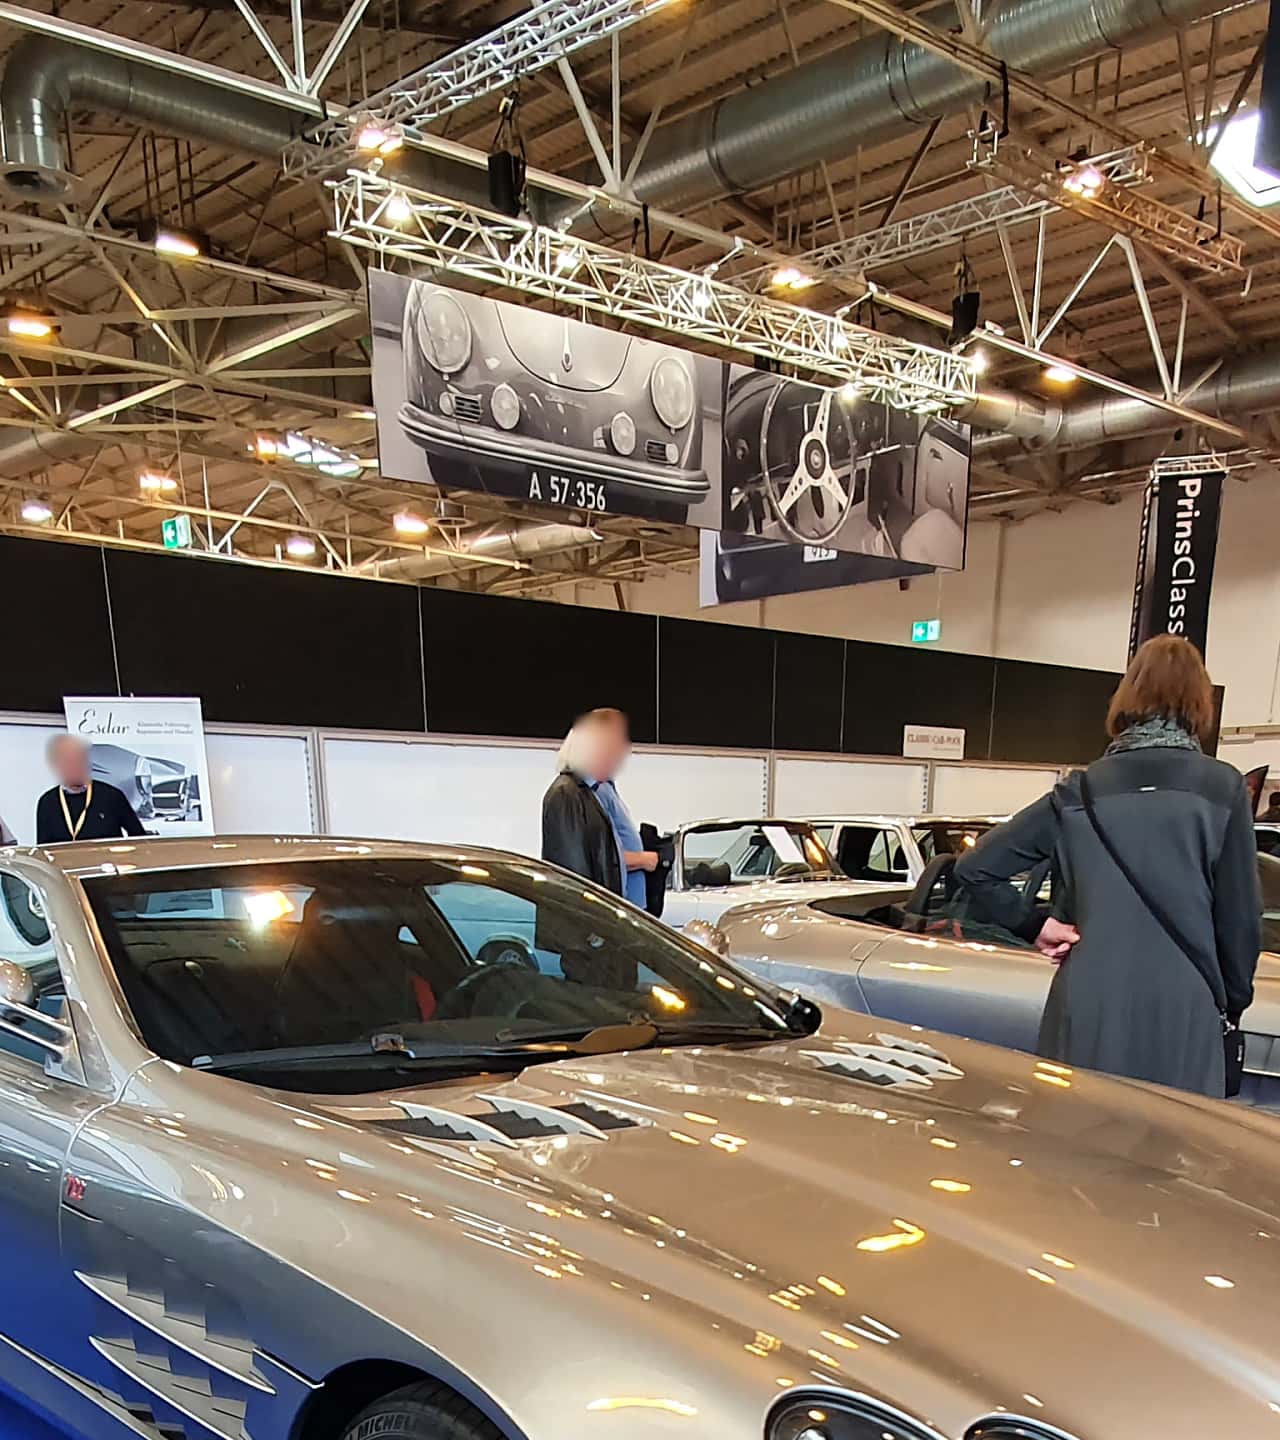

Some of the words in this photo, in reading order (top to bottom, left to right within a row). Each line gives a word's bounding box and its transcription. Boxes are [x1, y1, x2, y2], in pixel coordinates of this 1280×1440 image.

[528, 471, 543, 500] A
[1167, 477, 1202, 640] PrinsClass
[78, 708, 130, 735] Esdar
